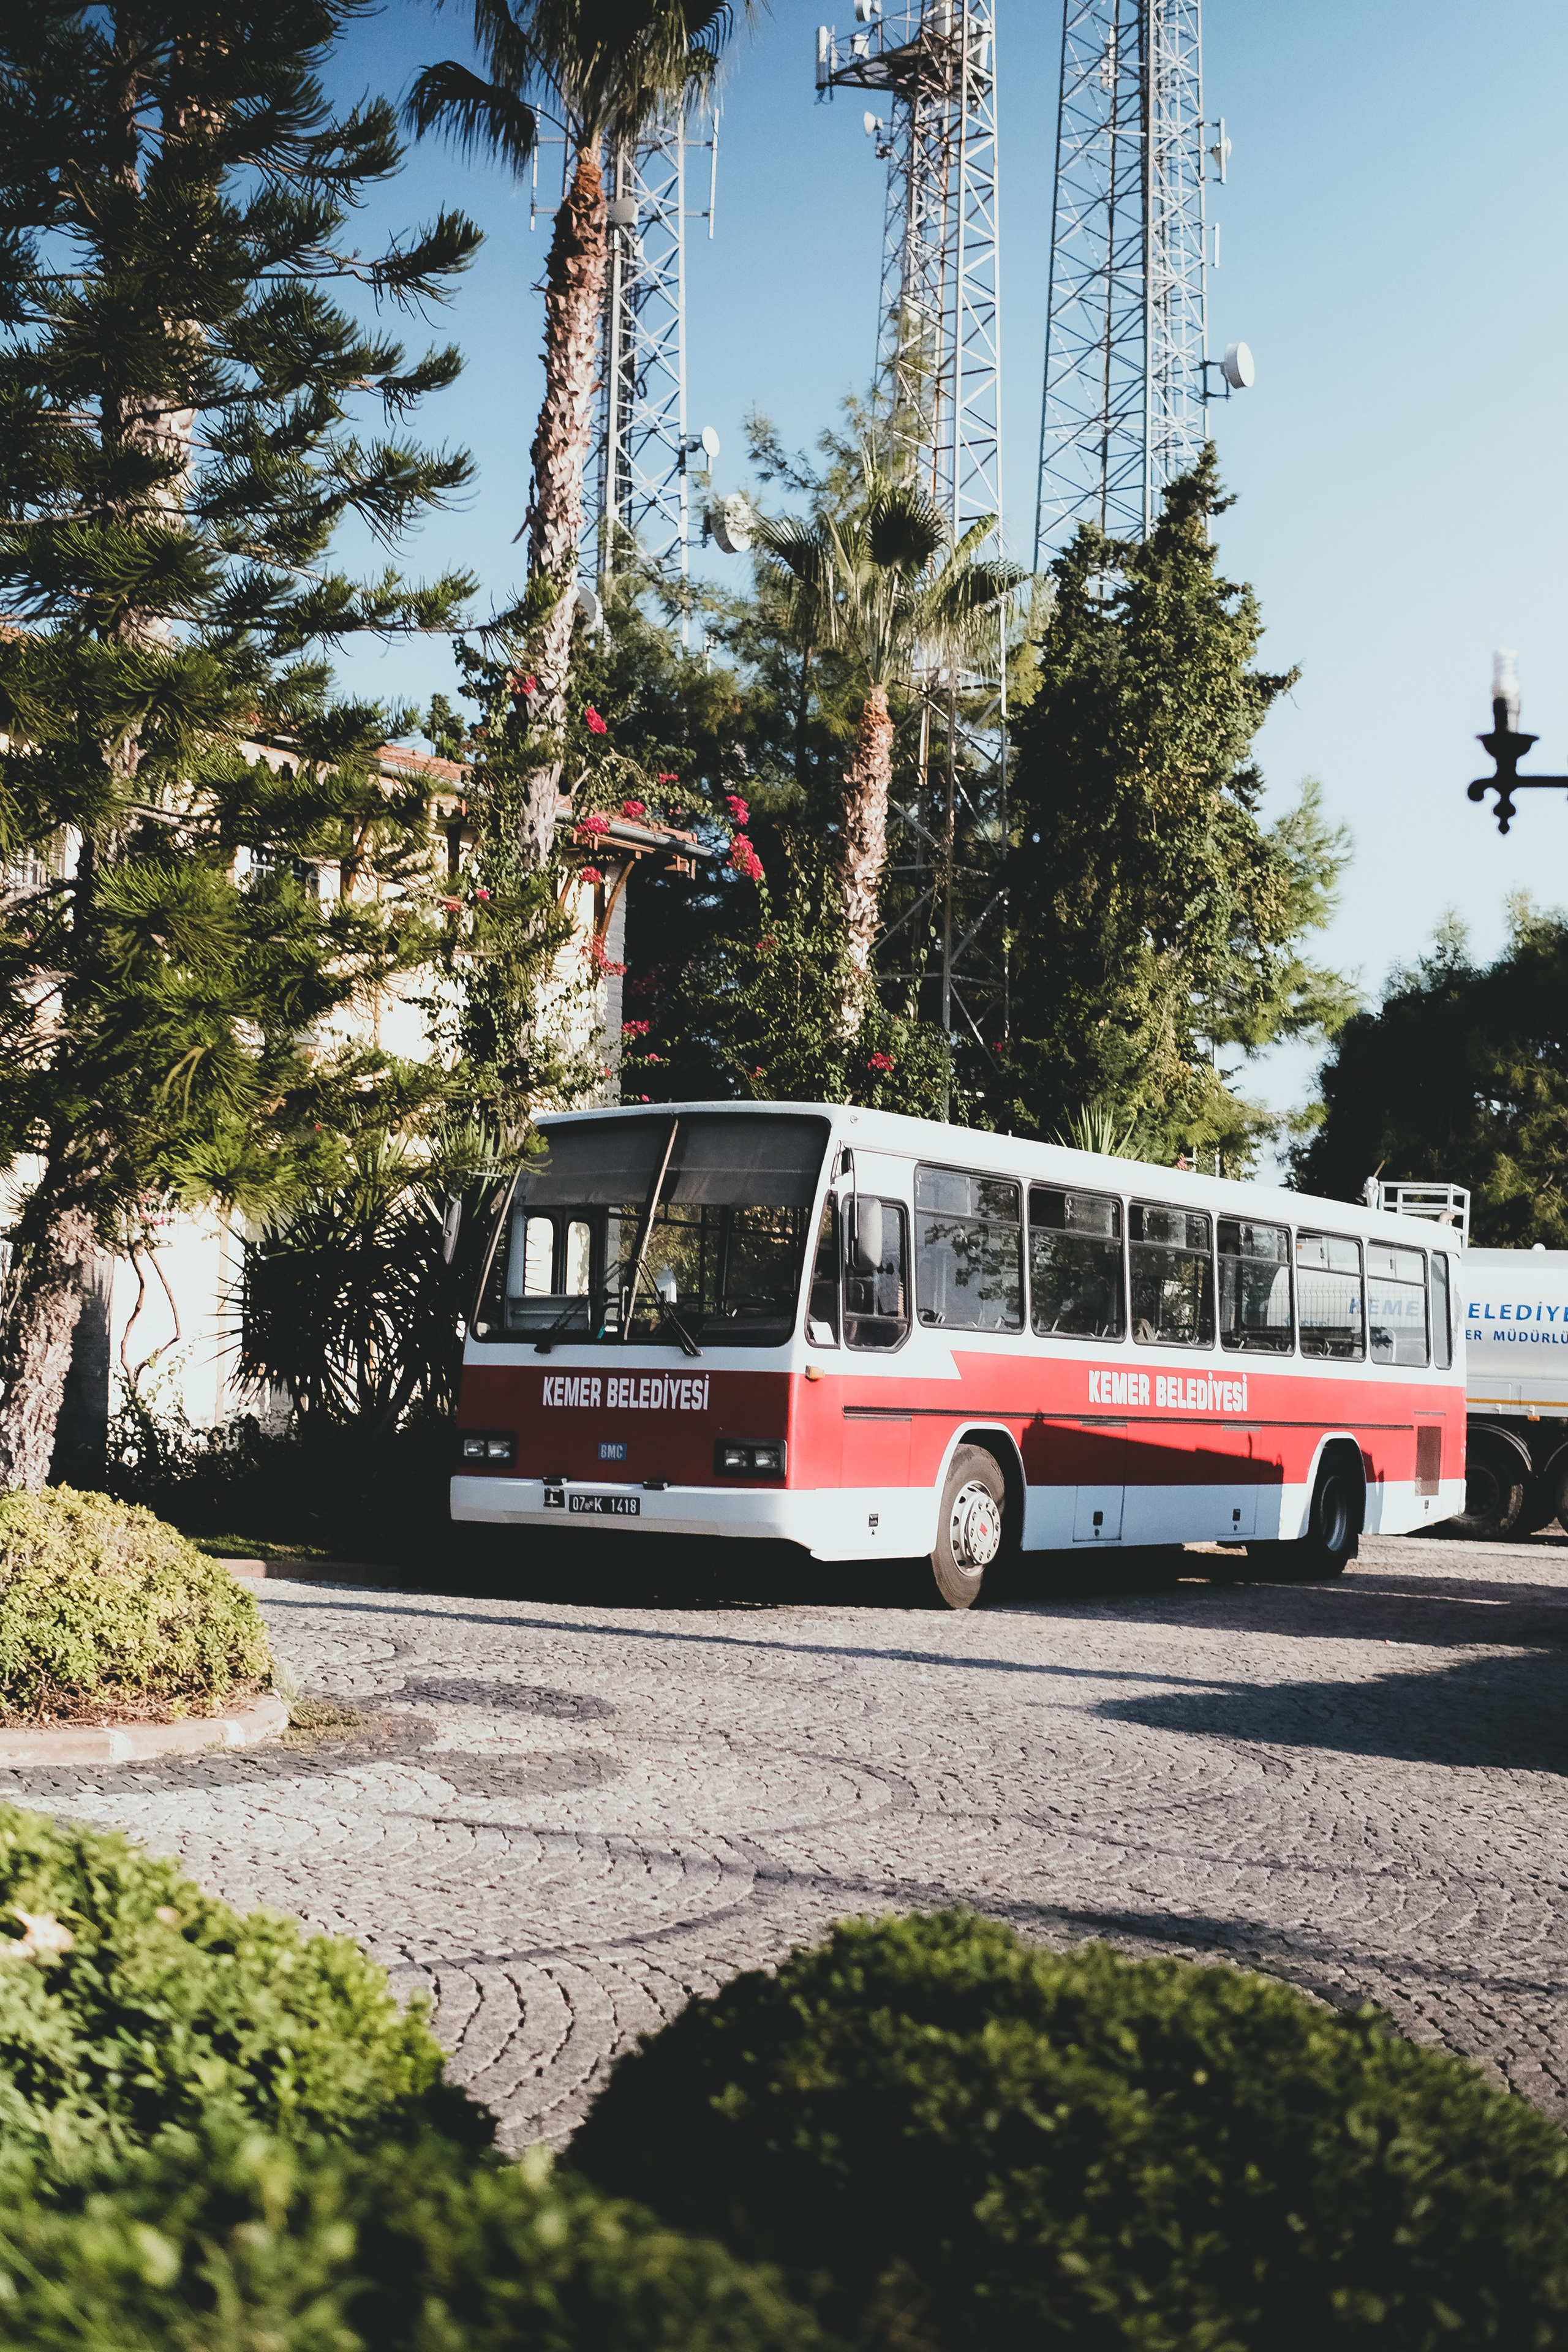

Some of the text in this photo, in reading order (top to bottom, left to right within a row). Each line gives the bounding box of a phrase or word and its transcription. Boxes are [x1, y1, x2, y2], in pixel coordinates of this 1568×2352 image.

[1349, 1298, 1568, 1322] KEME ELEDİY
[543, 1373, 709, 1410] KEMER BELEDİYESİ
[1089, 1370, 1247, 1412] KEMER BELEDİYESİ
[600, 1444, 623, 1458] BMC
[573, 1496, 636, 1513] 07 K 1418
